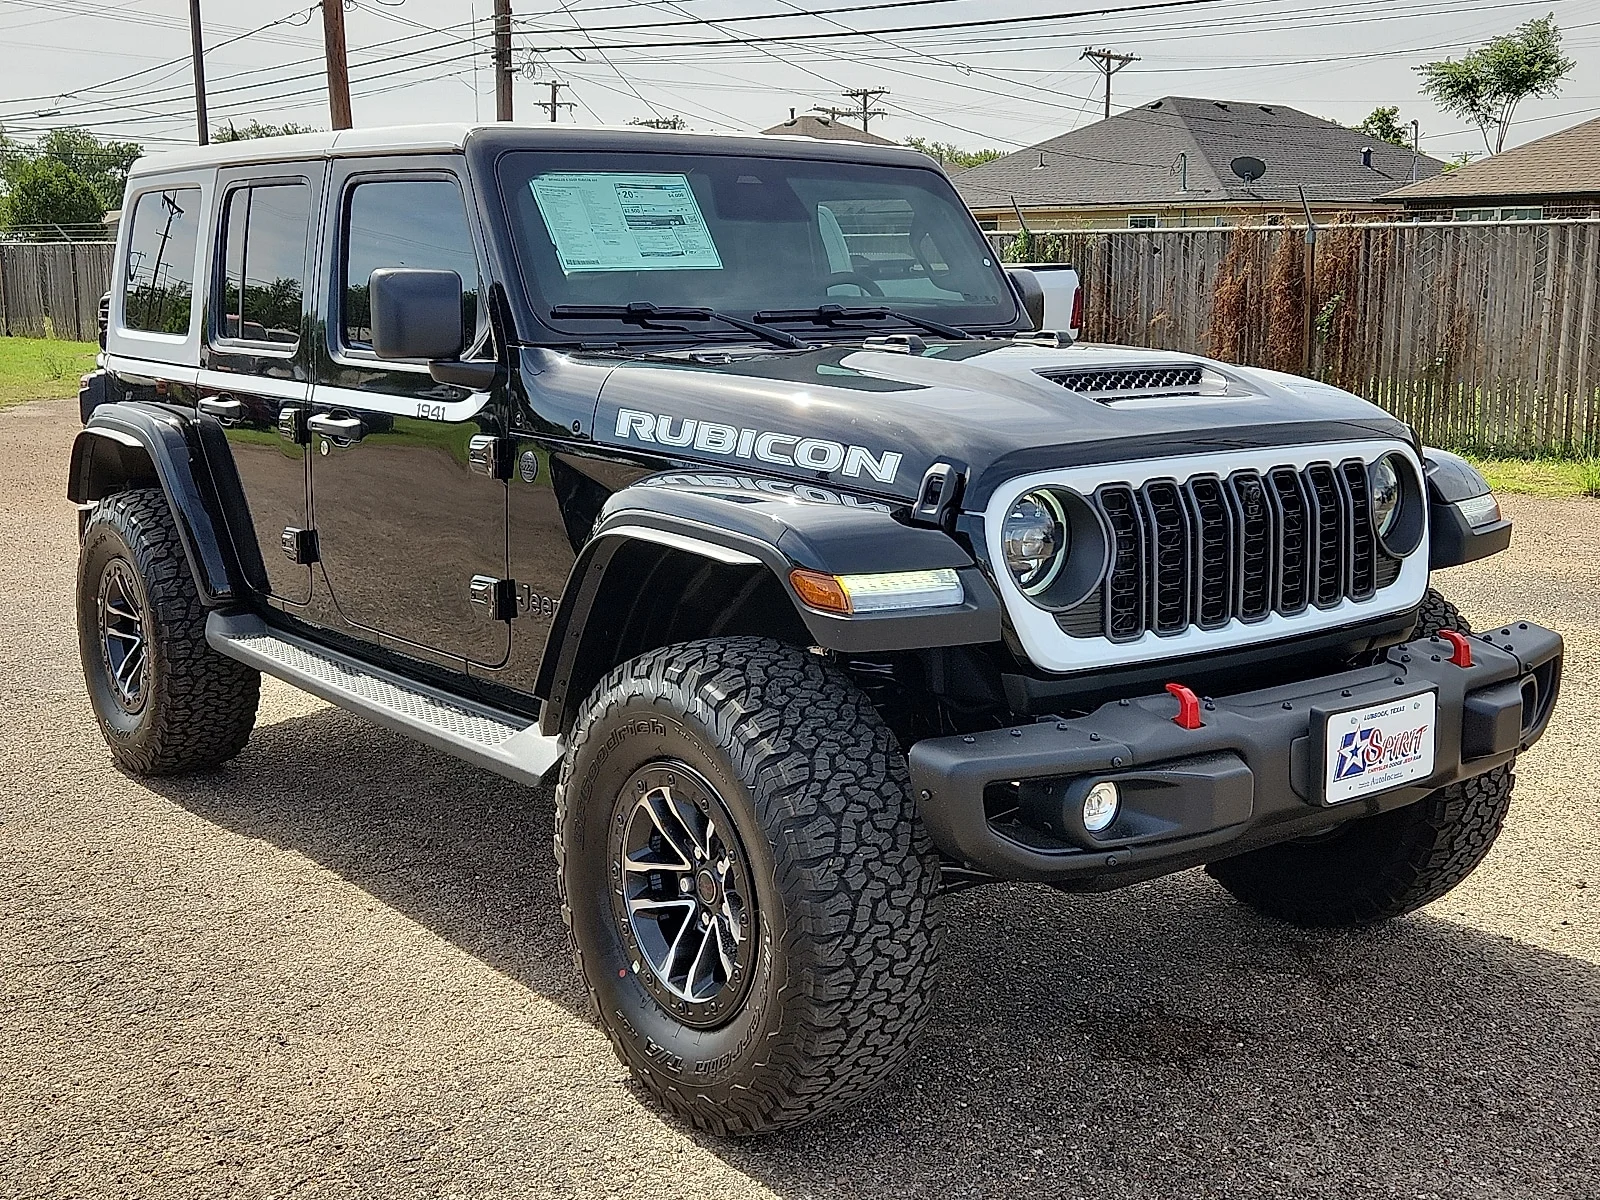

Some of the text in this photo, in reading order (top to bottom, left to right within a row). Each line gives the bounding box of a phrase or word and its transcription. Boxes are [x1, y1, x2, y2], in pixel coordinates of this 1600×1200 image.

[621, 190, 634, 199] 20
[416, 402, 447, 421] 1941
[614, 407, 904, 485] RUBICON
[1390, 705, 1406, 715] TEXAS
